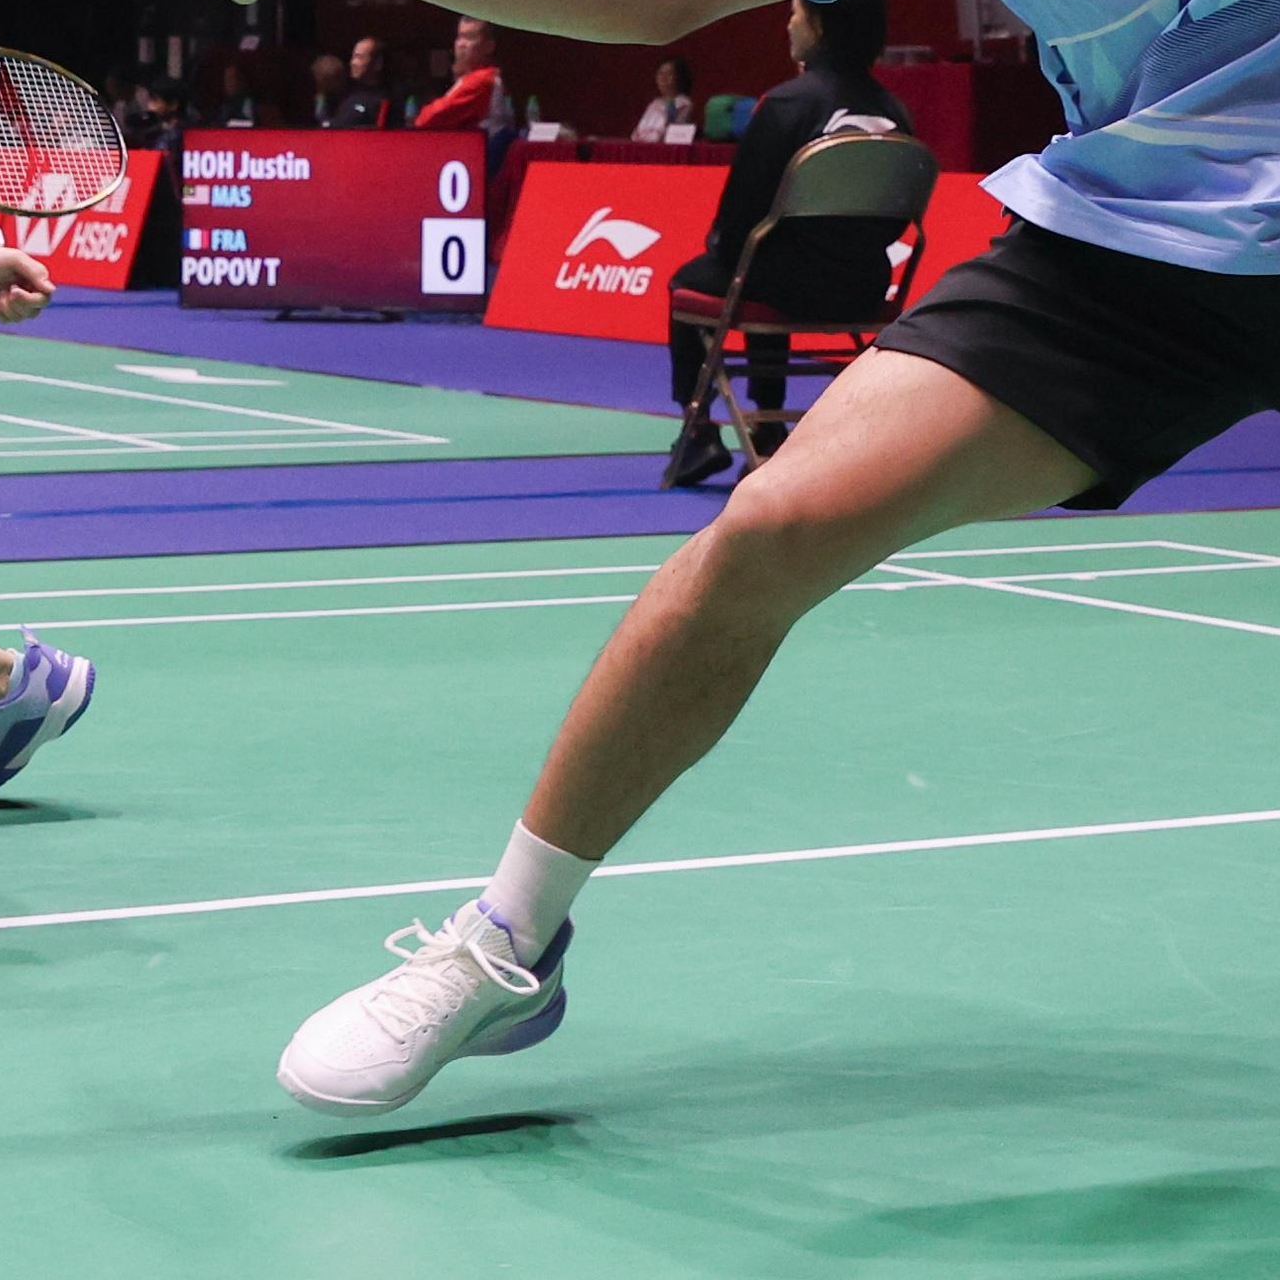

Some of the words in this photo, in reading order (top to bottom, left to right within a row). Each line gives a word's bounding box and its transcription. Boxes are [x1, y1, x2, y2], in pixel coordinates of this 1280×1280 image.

[183, 150, 235, 180] HOH
[237, 151, 310, 181] Justin
[211, 185, 251, 208] MAS
[439, 160, 470, 212] 0
[68, 221, 129, 263] HSBC
[211, 229, 247, 252] FRA
[182, 257, 260, 286] POPOV
[262, 257, 281, 287] T
[441, 236, 467, 281] 0
[555, 261, 655, 296] LI-NING
